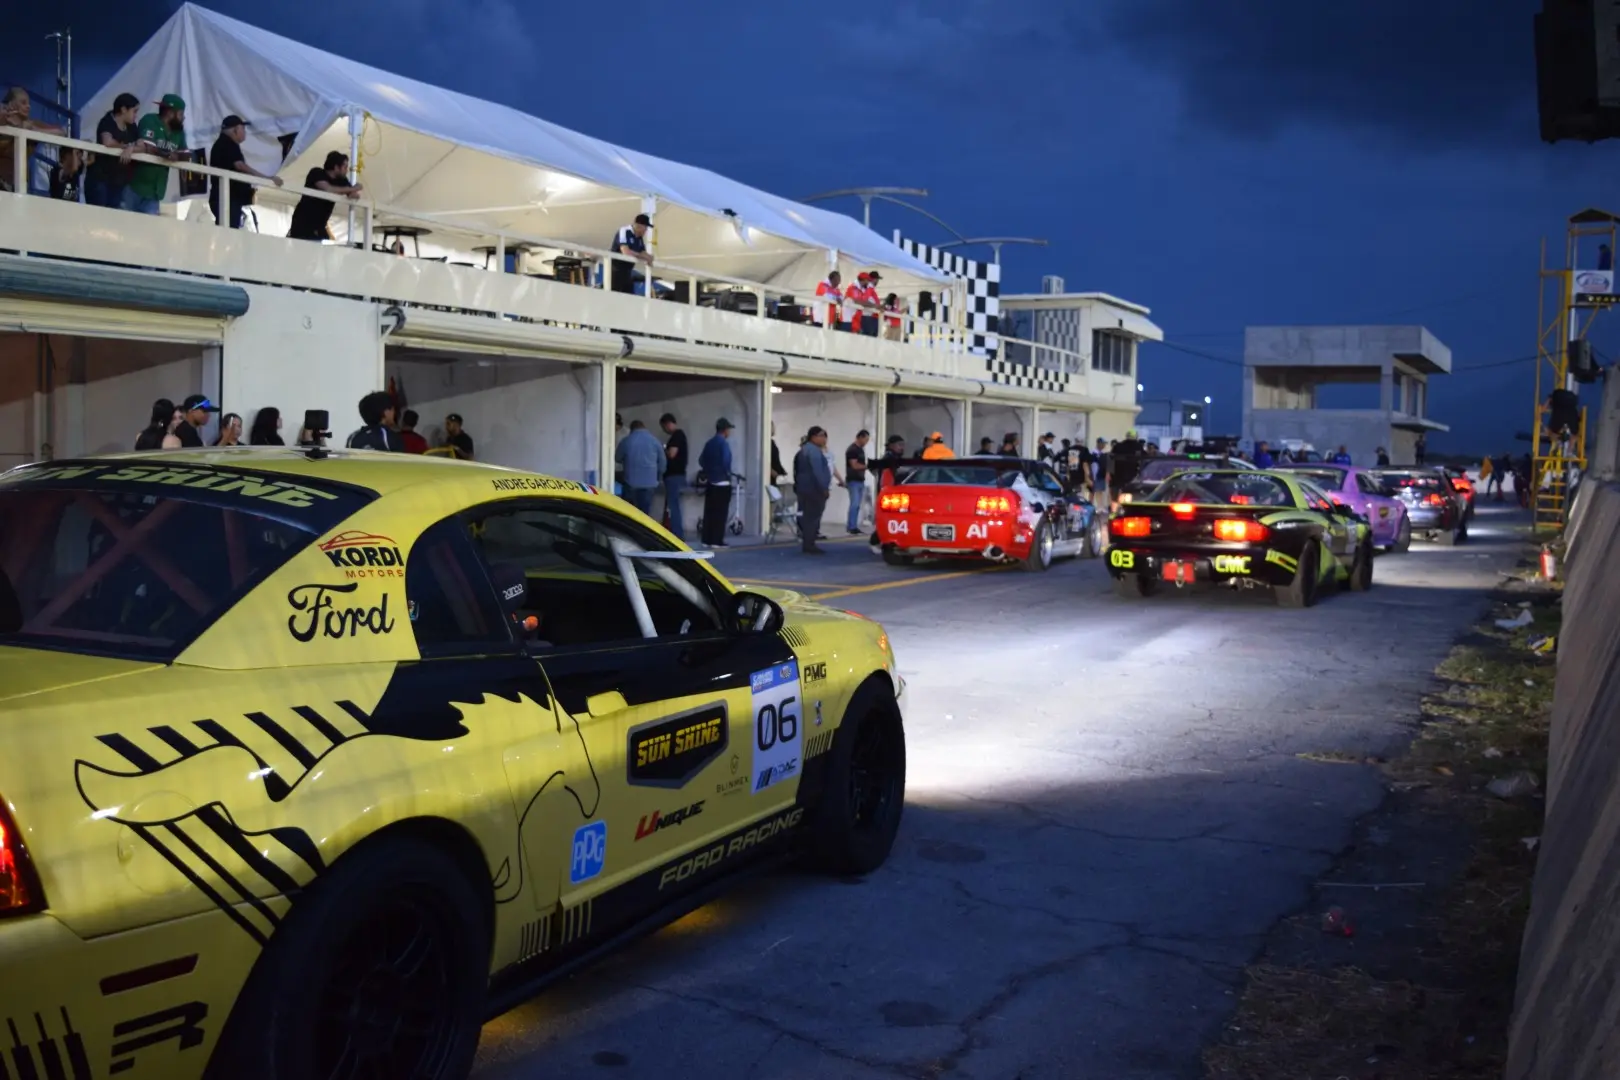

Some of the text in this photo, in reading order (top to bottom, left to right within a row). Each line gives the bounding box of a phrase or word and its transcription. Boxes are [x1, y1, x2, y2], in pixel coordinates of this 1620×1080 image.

[96, 466, 339, 507] SHINE
[492, 478, 525, 490] ANDRE
[526, 478, 566, 490] GARCIA
[888, 520, 908, 534] 04
[966, 523, 988, 538] AI
[325, 547, 404, 567] KORDI
[1111, 550, 1134, 568] 03
[1215, 555, 1251, 574] CMC
[345, 569, 404, 579] MOTORS
[287, 582, 395, 642] Ford
[804, 662, 827, 684] PMG
[757, 696, 797, 751] 06
[637, 718, 720, 767] SUN SHINE
[634, 799, 706, 842] UNIQUE
[573, 830, 605, 875] PPG
[658, 807, 804, 891] FORD RACING
